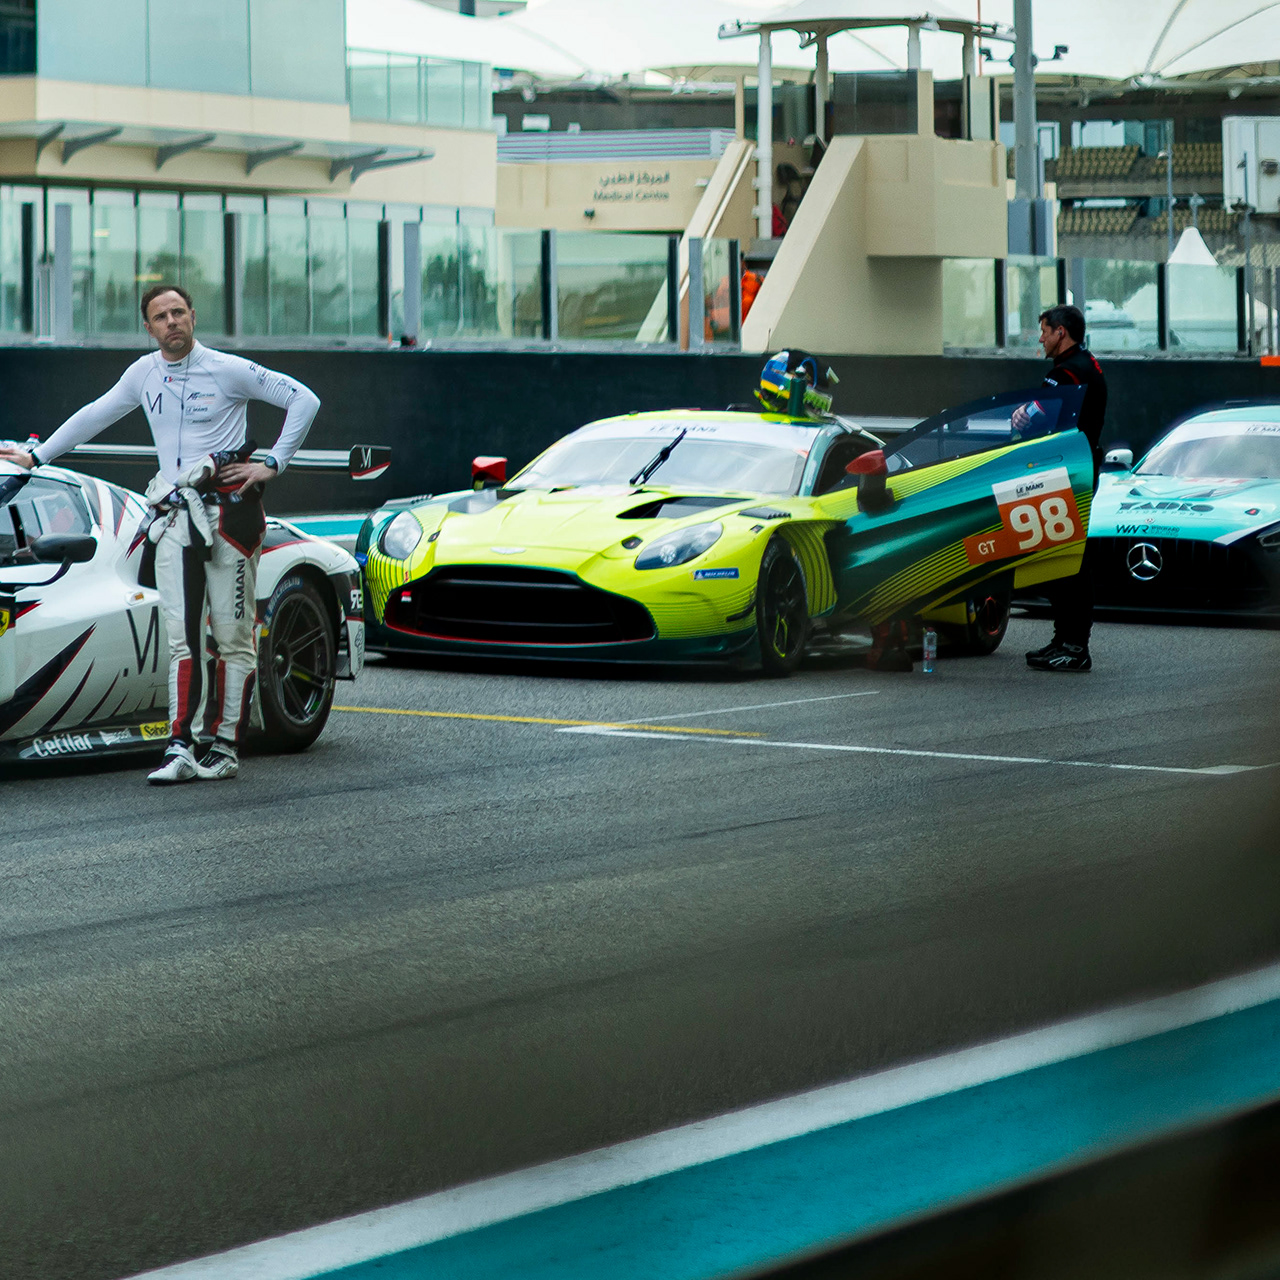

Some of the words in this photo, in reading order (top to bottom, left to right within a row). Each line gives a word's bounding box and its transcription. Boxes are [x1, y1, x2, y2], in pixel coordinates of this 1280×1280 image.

[1025, 482, 1045, 492] MANS
[1009, 496, 1076, 550] 98
[977, 540, 996, 555] GT
[233, 558, 246, 620] SAMANI
[32, 732, 94, 758] Cetilar
